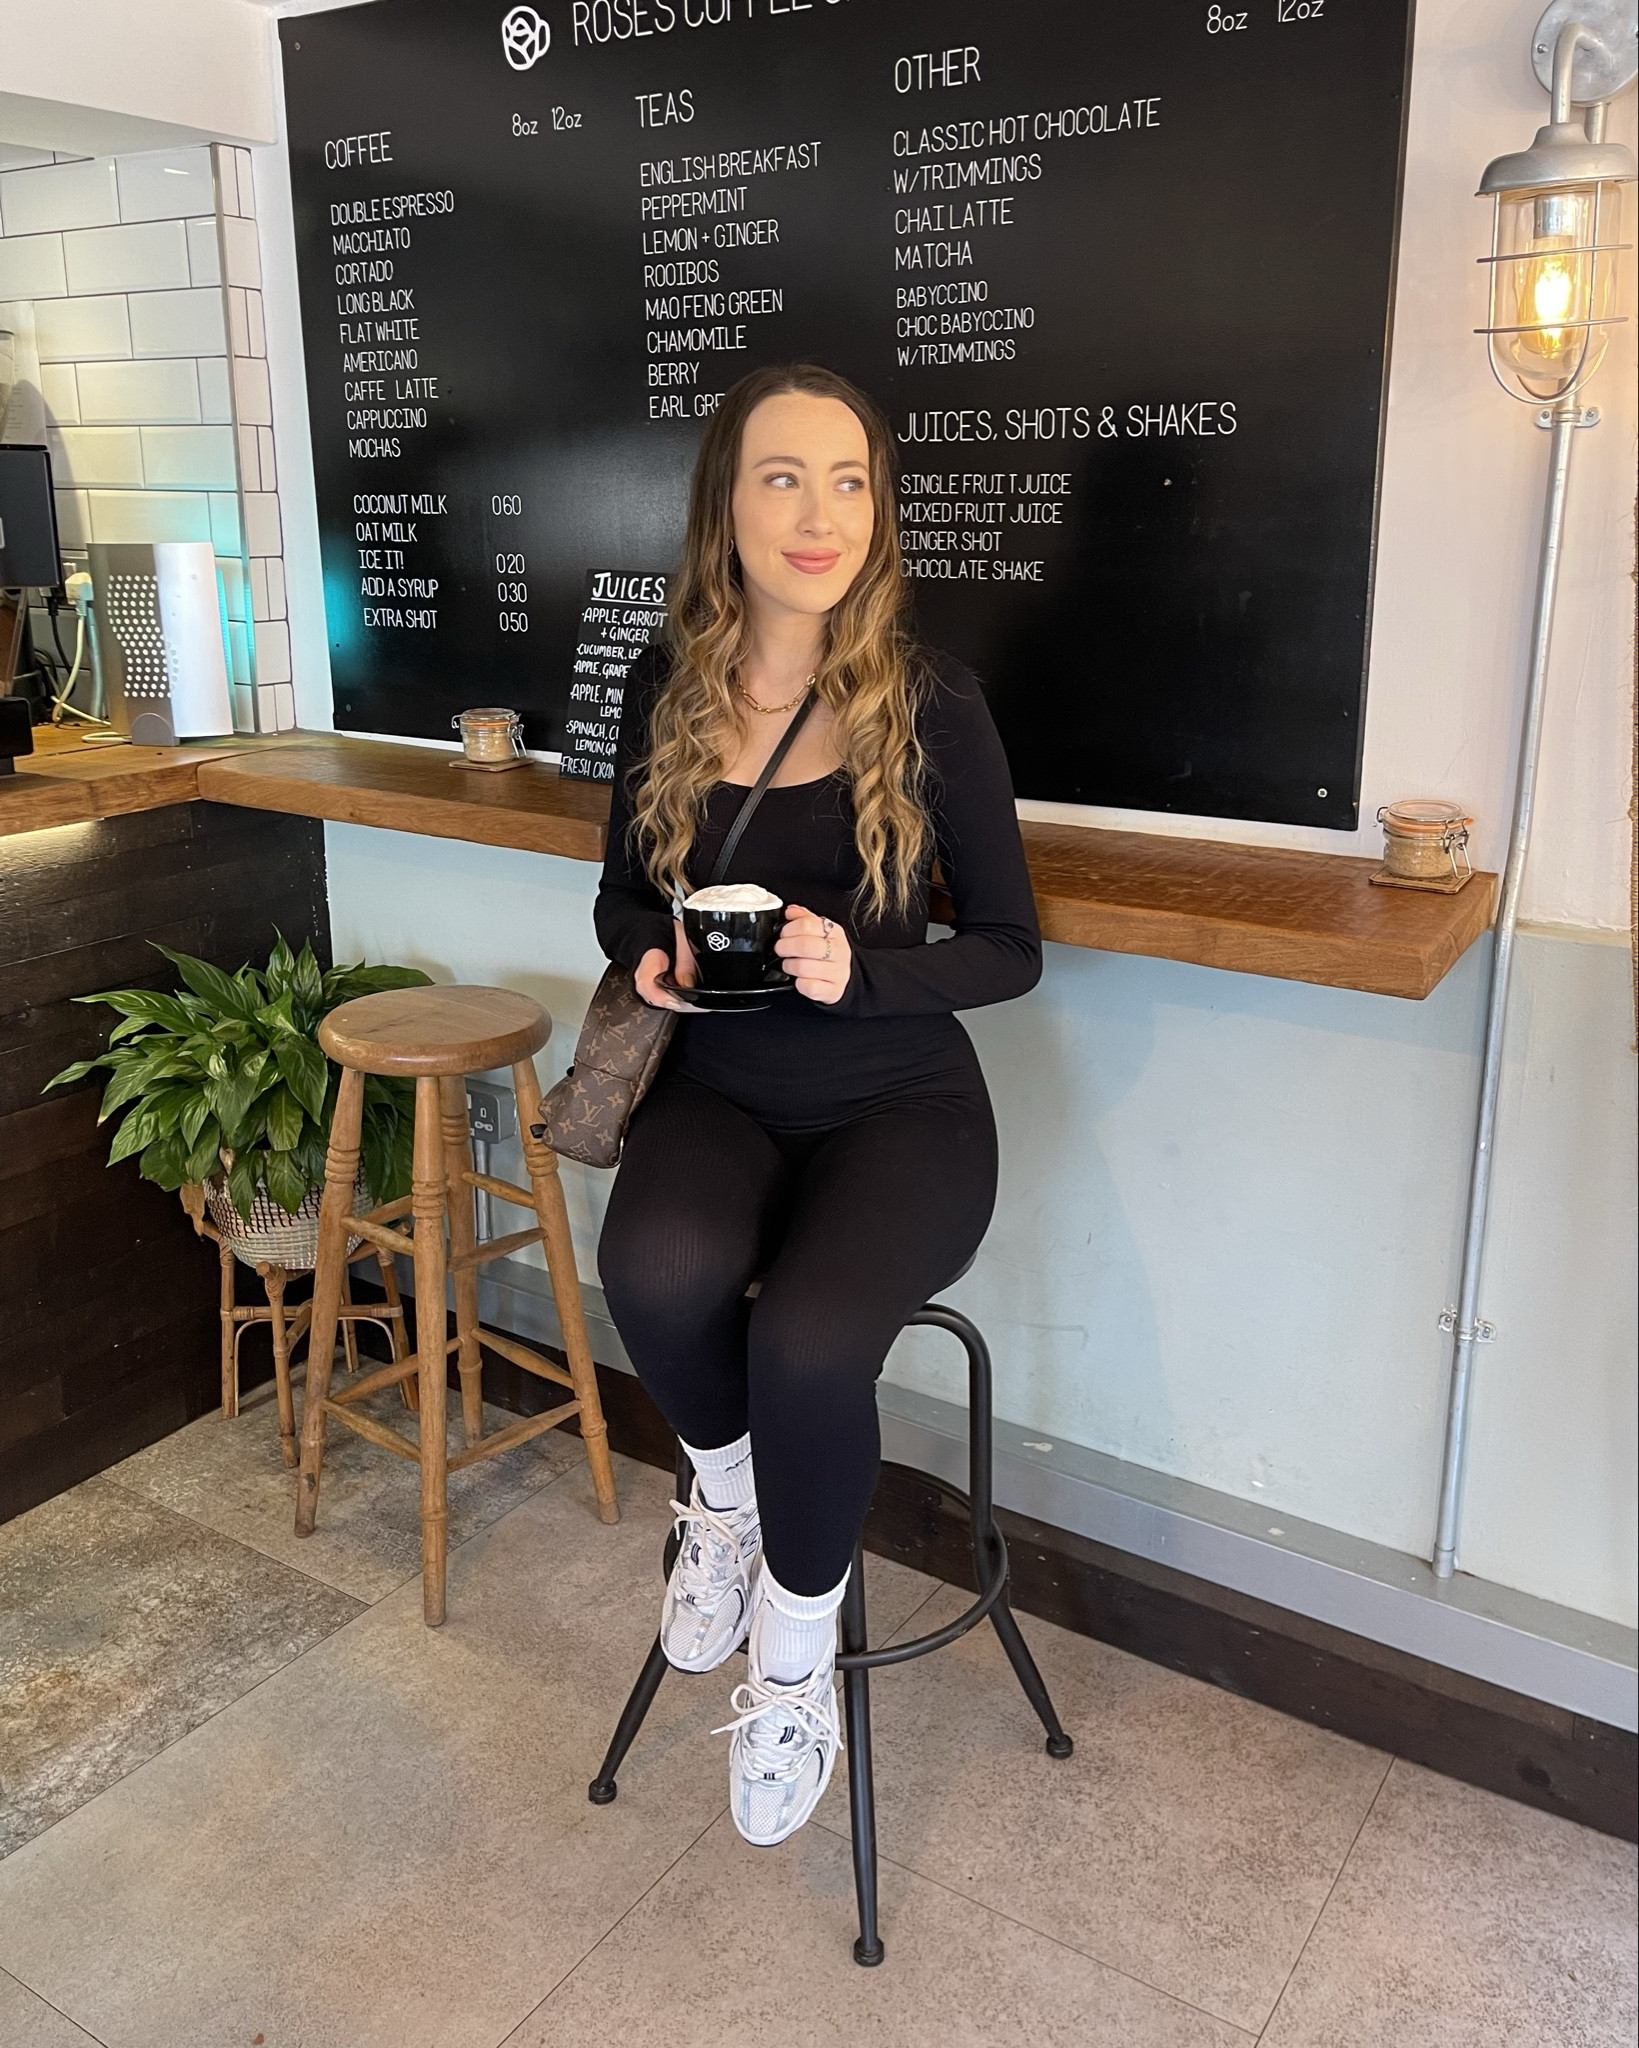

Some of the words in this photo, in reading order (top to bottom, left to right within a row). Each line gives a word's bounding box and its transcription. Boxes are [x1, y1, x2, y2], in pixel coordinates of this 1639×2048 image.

[573, 0, 675, 46] ROSES
[1207, 5, 1248, 34] 8oz
[1278, 0, 1324, 22] 12oz
[895, 47, 981, 93] OTHER
[512, 113, 538, 136] 8oz
[552, 106, 582, 130] 12oz
[635, 89, 694, 127] TEAS
[894, 121, 984, 156] CLASSIC
[989, 115, 1029, 145] HOT
[1035, 98, 1161, 140] CHOCOLATE
[325, 132, 393, 169] COFFEE
[641, 155, 715, 187] ENGLISH
[719, 142, 821, 177] BREAKFAST
[894, 153, 1041, 194] W/TRIMMINGS
[331, 199, 381, 226] DOUBLE
[383, 190, 454, 219] ESPRESSO
[642, 187, 747, 220] PEPPERMINT
[895, 205, 945, 234] CHAI
[950, 198, 1014, 229] LATTE
[333, 227, 410, 255] MACCHIATO
[643, 227, 697, 255] LEMON
[714, 219, 779, 248] GINGER
[896, 241, 972, 270] MATCHA
[336, 260, 393, 285] CORTADO
[644, 260, 719, 287] ROOIBOS
[338, 292, 370, 315] LONG
[372, 289, 414, 312] BLACK
[646, 297, 680, 320] MAO
[683, 293, 725, 318] FENG
[729, 289, 782, 315] GREEN
[897, 281, 987, 308] BABYCCINO
[340, 322, 372, 343] FLAT
[375, 318, 420, 341] WHITE
[897, 315, 937, 337] CHOC
[941, 307, 1034, 334] BABYCCINO
[647, 325, 747, 353] CHAMOMILE
[897, 339, 1015, 366] W/TRIMMINGS
[344, 349, 417, 372] AMERICANO
[648, 362, 699, 386] BERRY
[345, 380, 386, 401] CAFFE
[396, 378, 439, 399] LATTE
[347, 408, 427, 430] CAPPUCCINO
[650, 395, 690, 418] EARL
[898, 410, 997, 442] JUICES,
[1005, 407, 1090, 440] SHOTS
[1098, 406, 1118, 438] &
[1126, 402, 1236, 437] SHAKES
[349, 438, 401, 458] MOCHAS
[901, 474, 959, 494] SINGLE
[963, 474, 1018, 494] FRUIT
[1018, 474, 1072, 494] JUICE
[354, 494, 408, 514] COCONUT
[411, 494, 447, 514] MILK
[900, 503, 952, 522] MIXED
[955, 503, 1006, 523] FRUIT
[1010, 503, 1063, 523] JUICE
[356, 522, 379, 541] OAT
[382, 523, 417, 542] MILK
[900, 531, 958, 550] GINGER
[961, 532, 1002, 551] SHOT
[358, 550, 383, 569] ICE
[384, 550, 404, 569] IT!
[901, 559, 988, 579] CHOCOLATE
[992, 561, 1044, 581] SHAKE
[362, 577, 385, 596] ADD
[387, 578, 396, 596] A
[398, 578, 438, 598] SYRUP
[592, 572, 666, 603] JUICES
[364, 608, 404, 627] EXTRA
[406, 609, 437, 629] SHOT
[623, 610, 668, 627] CARROT
[609, 626, 649, 644] GINGER
